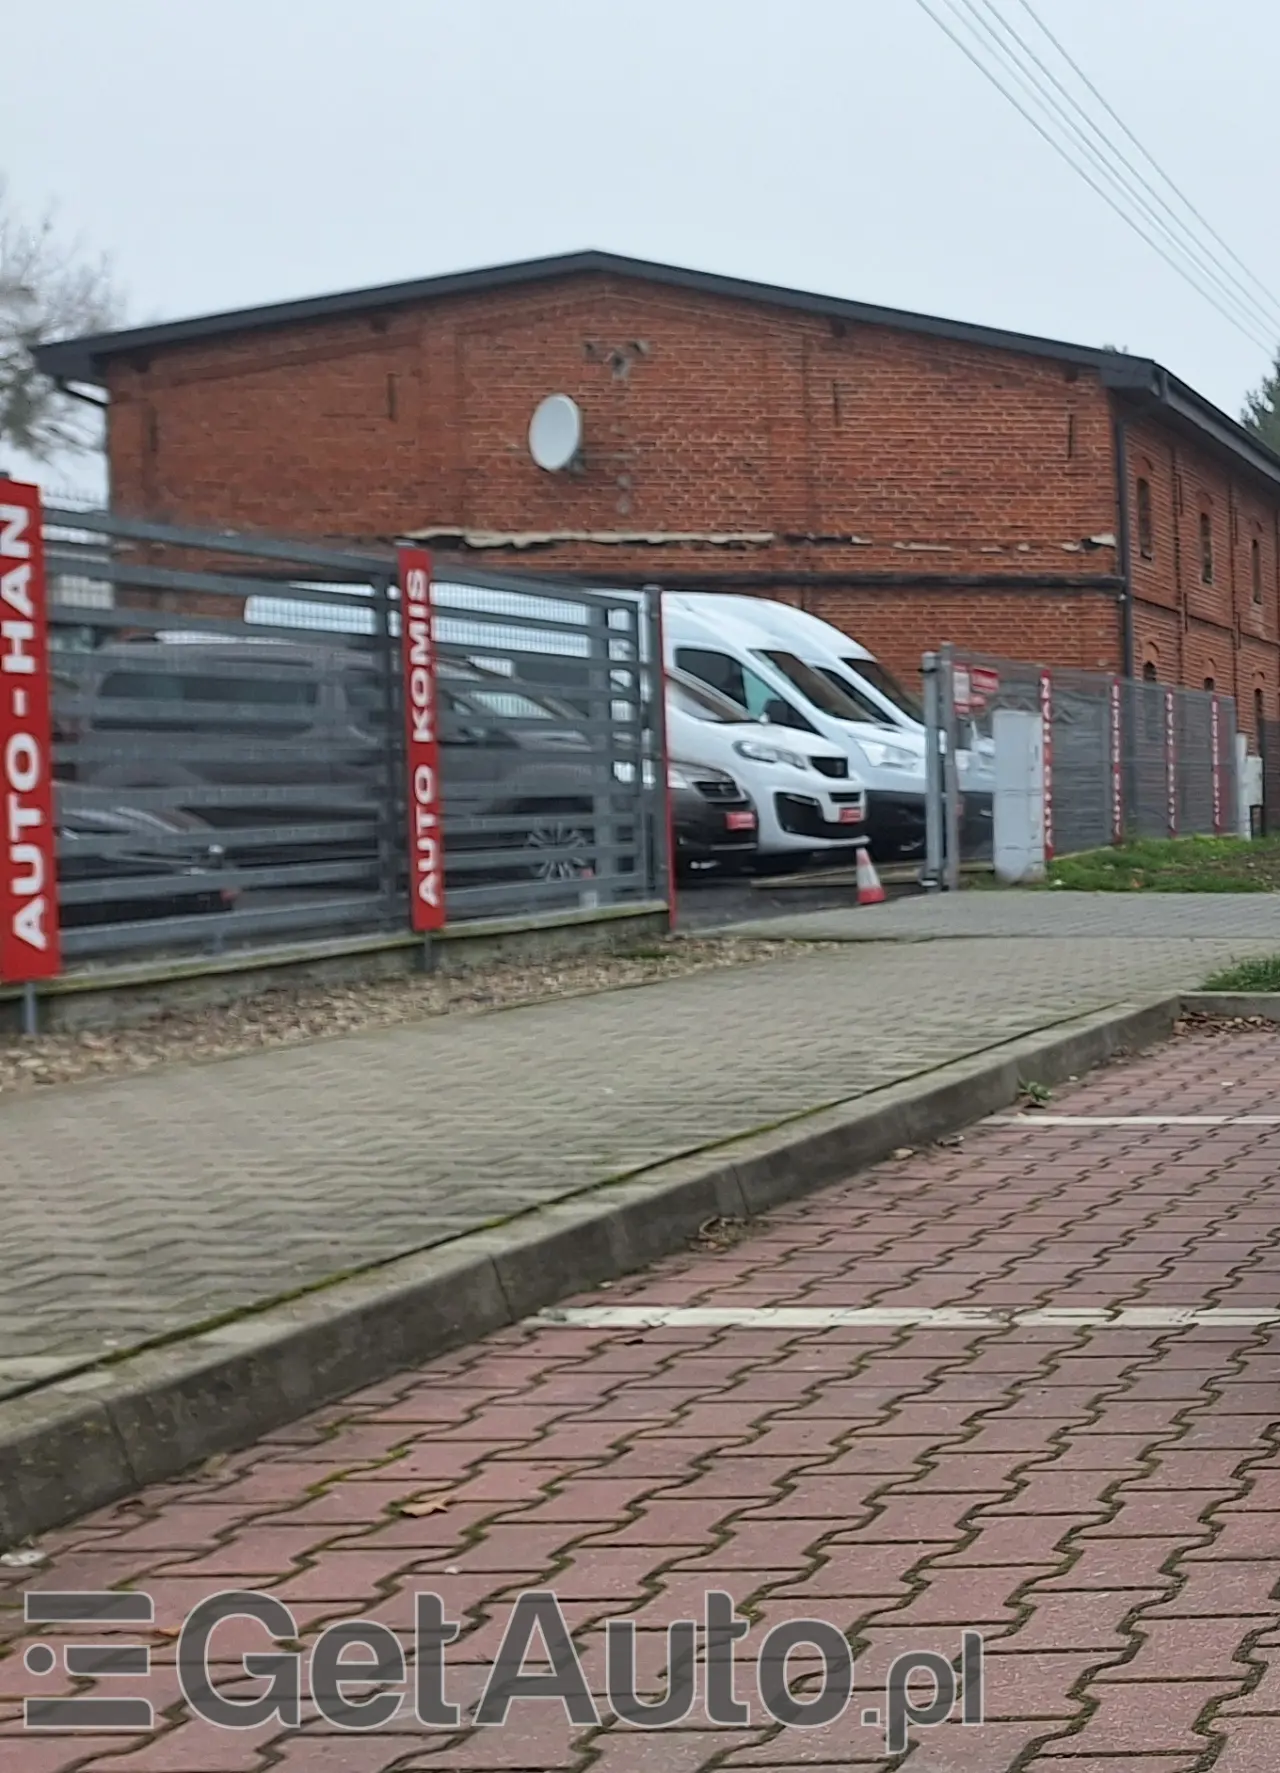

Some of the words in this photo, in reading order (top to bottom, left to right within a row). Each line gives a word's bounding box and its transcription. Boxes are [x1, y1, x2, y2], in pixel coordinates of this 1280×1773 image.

[0, 504, 36, 674] HAN
[404, 568, 433, 744] KOMIS
[5, 732, 47, 950] AUTO
[413, 763, 439, 907] AUTO
